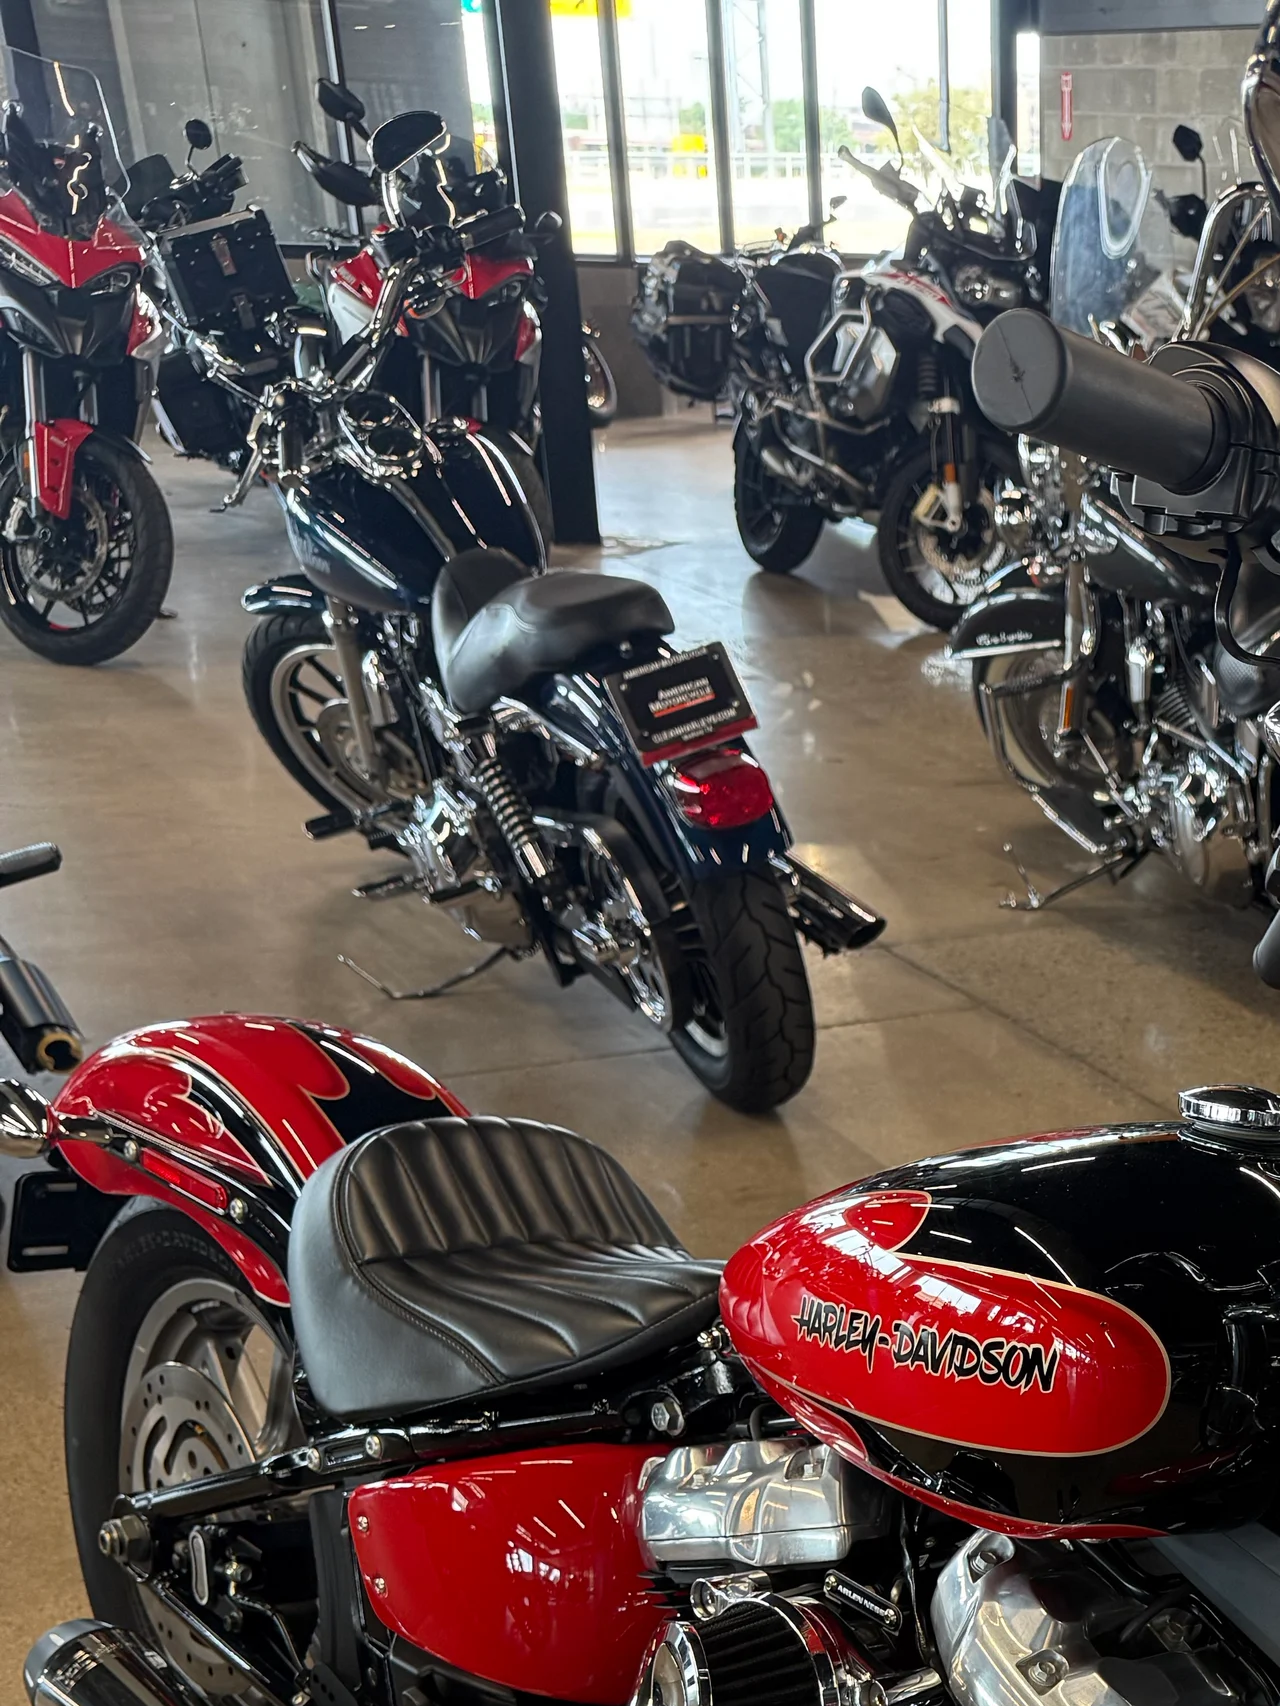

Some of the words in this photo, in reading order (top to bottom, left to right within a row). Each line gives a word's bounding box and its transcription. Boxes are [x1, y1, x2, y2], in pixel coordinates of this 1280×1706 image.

[791, 1295, 1060, 1395] HARLEY-DAVIDSON
[837, 1584, 863, 1605] ARLEN
[863, 1598, 886, 1617] NESS
